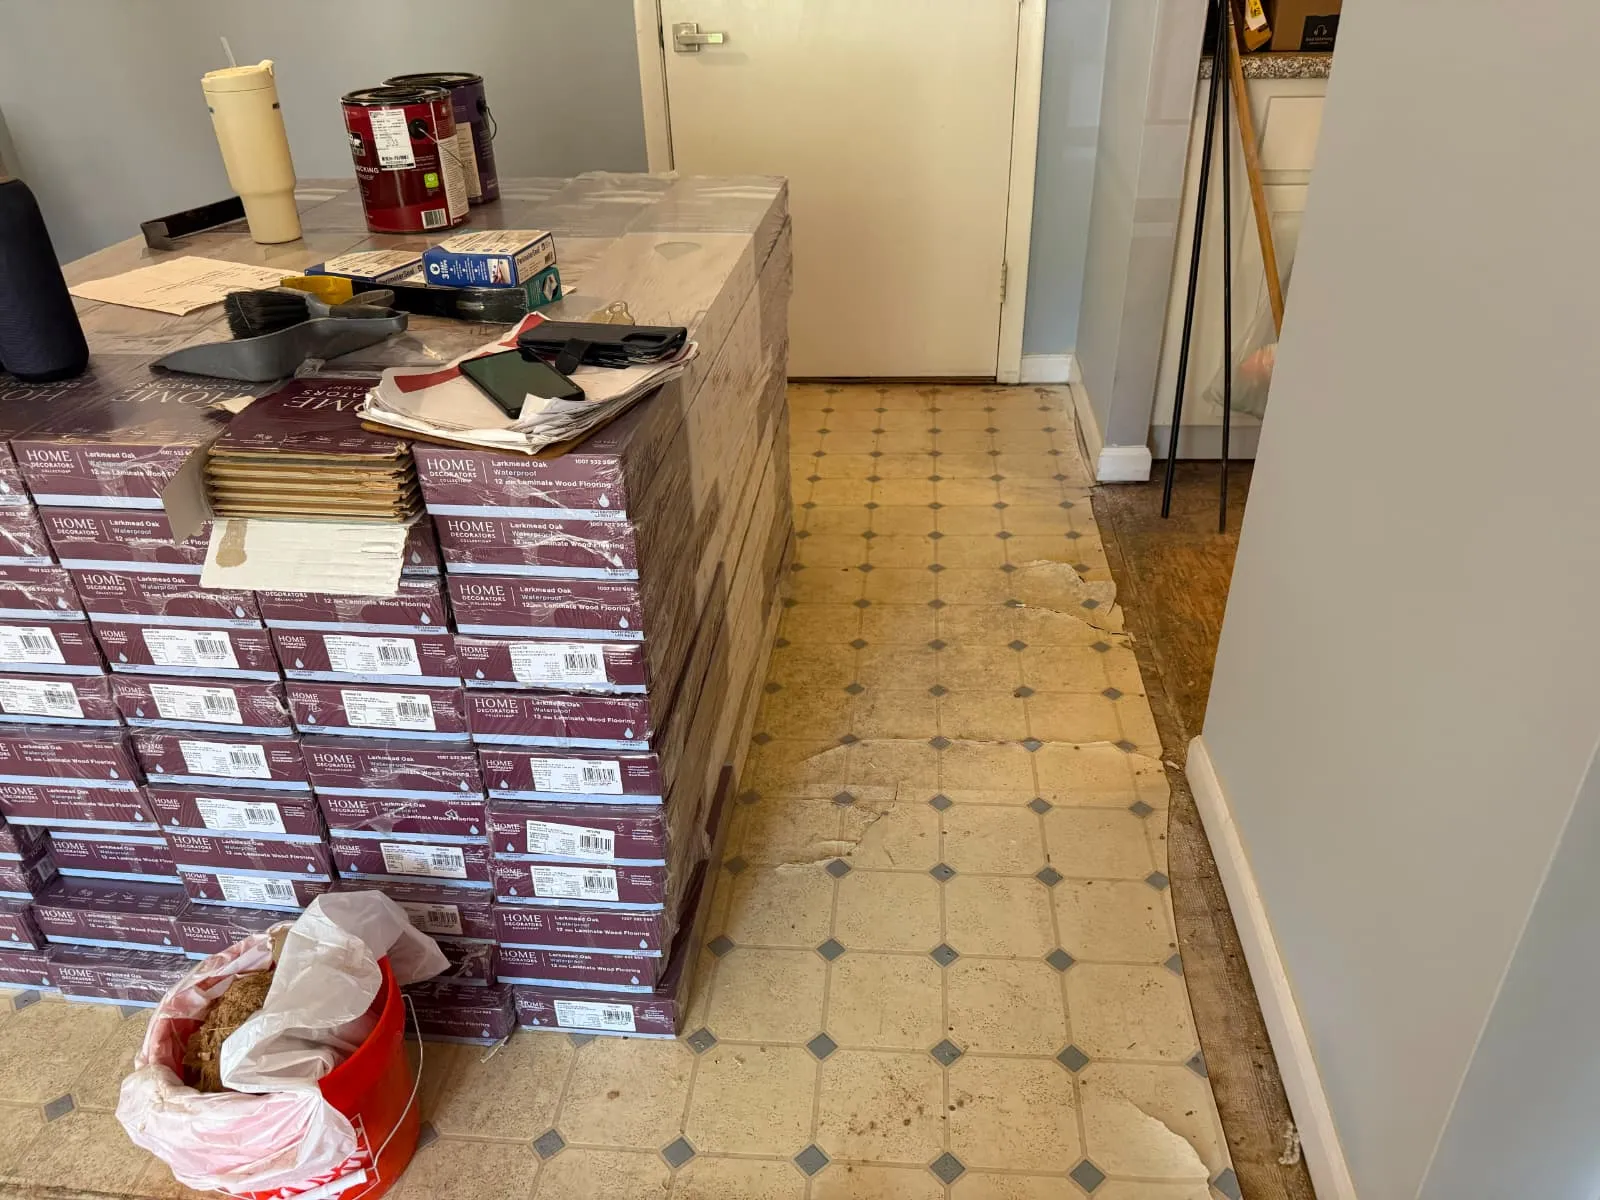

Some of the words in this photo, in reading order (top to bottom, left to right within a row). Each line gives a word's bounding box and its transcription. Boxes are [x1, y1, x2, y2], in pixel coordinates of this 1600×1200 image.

[301, 389, 365, 398] ATORS
[27, 450, 72, 462] HOME
[85, 451, 120, 459] Larkmead
[427, 458, 476, 471] HOME
[491, 460, 530, 468] Larkmead
[494, 469, 537, 477] Waterproof
[519, 479, 553, 487] Laminate
[579, 481, 612, 489] Flooring
[52, 518, 97, 530] HOME
[448, 521, 495, 532] HOME
[510, 522, 547, 530] Larkmead
[571, 540, 592, 548] Wood
[83, 575, 124, 585] HOME
[460, 585, 505, 596] HOME
[579, 603, 599, 611] Wood
[600, 605, 631, 613] Flooring
[475, 698, 518, 708] HOME
[313, 754, 355, 763] HOME
[0, 787, 37, 795] HOME
[328, 800, 368, 809] HOME
[173, 835, 211, 845] HOME
[53, 841, 87, 851] HOME
[40, 910, 75, 919] HOME
[502, 914, 542, 922] HOME
[183, 926, 218, 935] HOME
[500, 950, 536, 959] HOME
[59, 968, 94, 977] HOME
